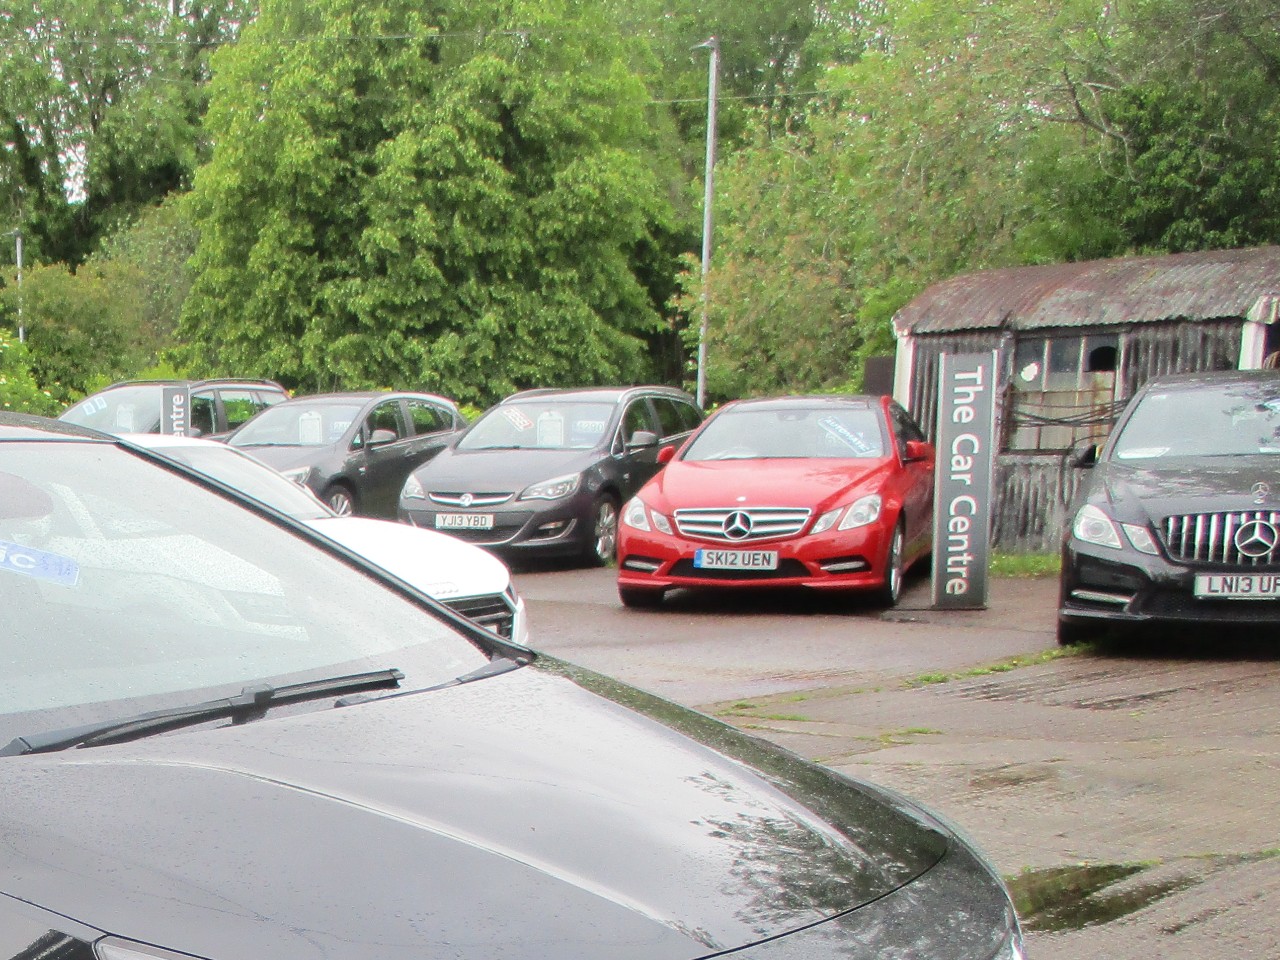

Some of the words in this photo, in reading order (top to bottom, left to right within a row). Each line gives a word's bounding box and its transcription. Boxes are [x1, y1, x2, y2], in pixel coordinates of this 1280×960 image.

[952, 366, 984, 424] The
[950, 434, 980, 486] Car
[706, 552, 738, 565] SK12
[742, 553, 771, 566] UEN
[945, 495, 977, 595] Centre
[1208, 576, 1252, 594] LN13
